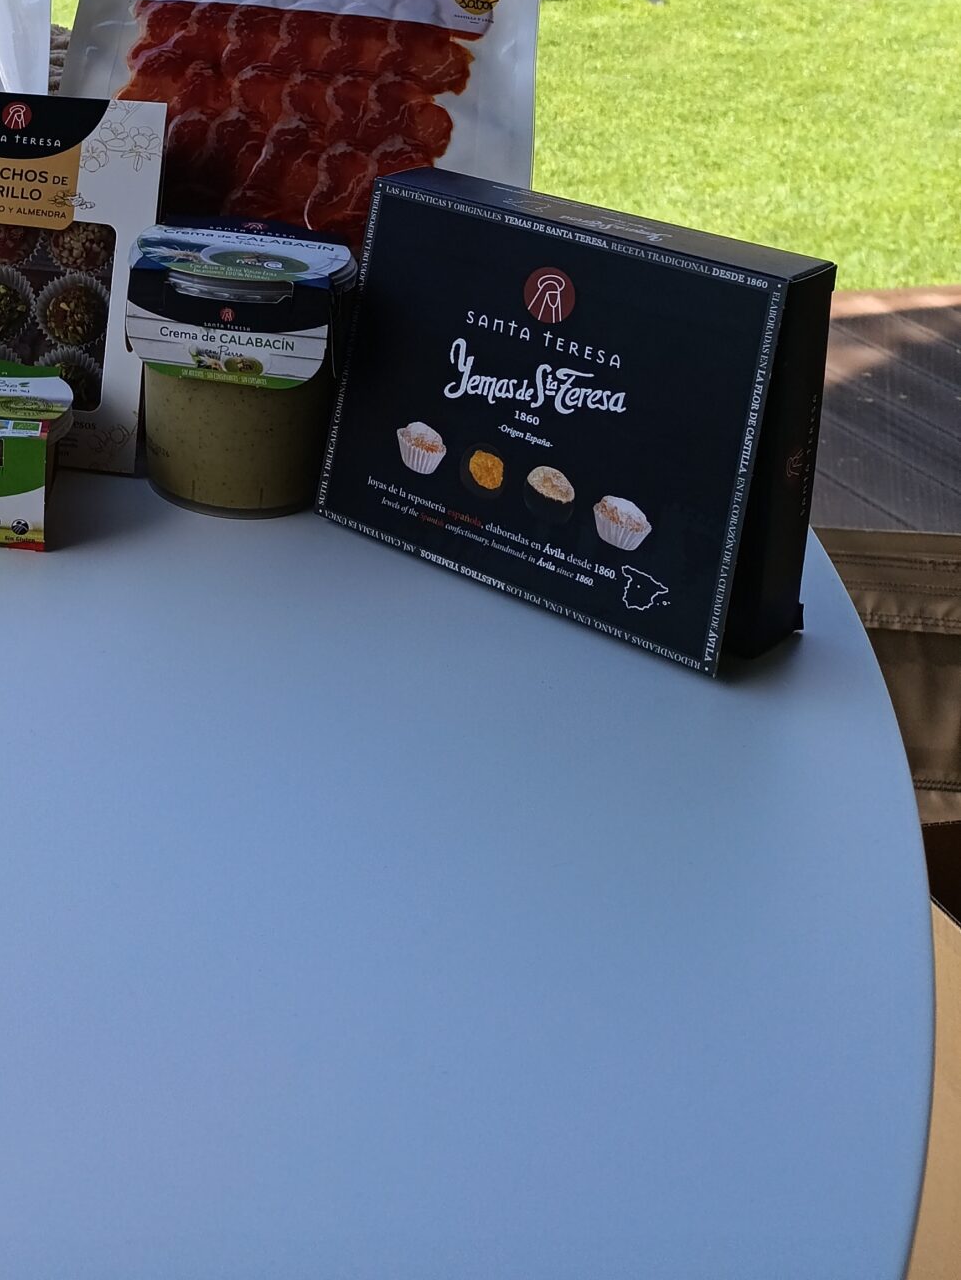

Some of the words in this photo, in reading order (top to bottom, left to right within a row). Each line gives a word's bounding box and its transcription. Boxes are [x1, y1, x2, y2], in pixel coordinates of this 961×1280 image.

[14, 132, 62, 148] TERESA
[52, 175, 69, 186] DE
[16, 208, 67, 220] ALMENDRA
[362, 249, 370, 261] DE
[366, 190, 381, 240] REPOSTERÍA
[163, 229, 214, 238] Crema
[235, 235, 335, 252] CALABACÍN
[385, 185, 399, 195] LAS
[399, 187, 447, 207] AUTÉNTICAS
[446, 201, 453, 209] Y
[453, 202, 502, 221] ORIGINALES
[503, 215, 532, 229] YEMAS
[533, 222, 545, 232] DE
[545, 225, 573, 239] SANTA
[610, 241, 646, 257] RECETA
[646, 250, 711, 274] TRADICIONAL
[711, 266, 744, 282] DESDE
[746, 275, 768, 288] 1860
[761, 291, 780, 353] ELABORADAS
[159, 326, 197, 340] Crema
[201, 332, 216, 342] de
[219, 333, 295, 351] CALABACÍN
[465, 307, 532, 342] SANTA
[541, 329, 622, 369] TERESA
[758, 354, 769, 369] EN
[444, 338, 517, 405] Yemas
[515, 379, 533, 402] de
[554, 368, 627, 414] Teresa
[756, 369, 766, 383] LA
[751, 383, 763, 410] FLOR
[513, 409, 540, 426] 1860
[747, 411, 758, 427] DE
[318, 478, 328, 506] SUTIL
[325, 424, 338, 470] DELICADA
[735, 476, 745, 490] EN
[733, 491, 743, 504] EL
[323, 510, 347, 526] ÚNICA
[348, 519, 357, 530] ES
[357, 523, 379, 539] YEMA
[367, 475, 387, 492] Joyas
[387, 482, 398, 495] de
[398, 486, 406, 498] la
[406, 490, 446, 515] repostería
[485, 520, 529, 546] elaboradas
[530, 540, 541, 550] en
[542, 541, 566, 560] Ávila
[566, 551, 592, 570] desde
[593, 562, 618, 580] 1860.
[724, 503, 742, 550] CORAZÓN
[378, 532, 400, 548] CADA
[381, 496, 400, 510] Jewels
[400, 503, 409, 515] of
[408, 506, 419, 517] the
[490, 538, 527, 560] handmade
[527, 553, 536, 563] in
[536, 555, 556, 571] Ávila
[556, 565, 574, 578] since
[721, 550, 731, 565] DE
[460, 565, 505, 590] MAESTROS
[719, 565, 729, 579] LA
[506, 583, 522, 597] LOS
[523, 590, 541, 605] POR
[712, 577, 726, 616] CIUDAD
[564, 607, 571, 617] A
[572, 610, 591, 625] UNA
[709, 615, 719, 630] DE
[623, 631, 630, 641] A
[631, 634, 701, 669] REDONDEADAS
[703, 629, 718, 663] ÁVILA
